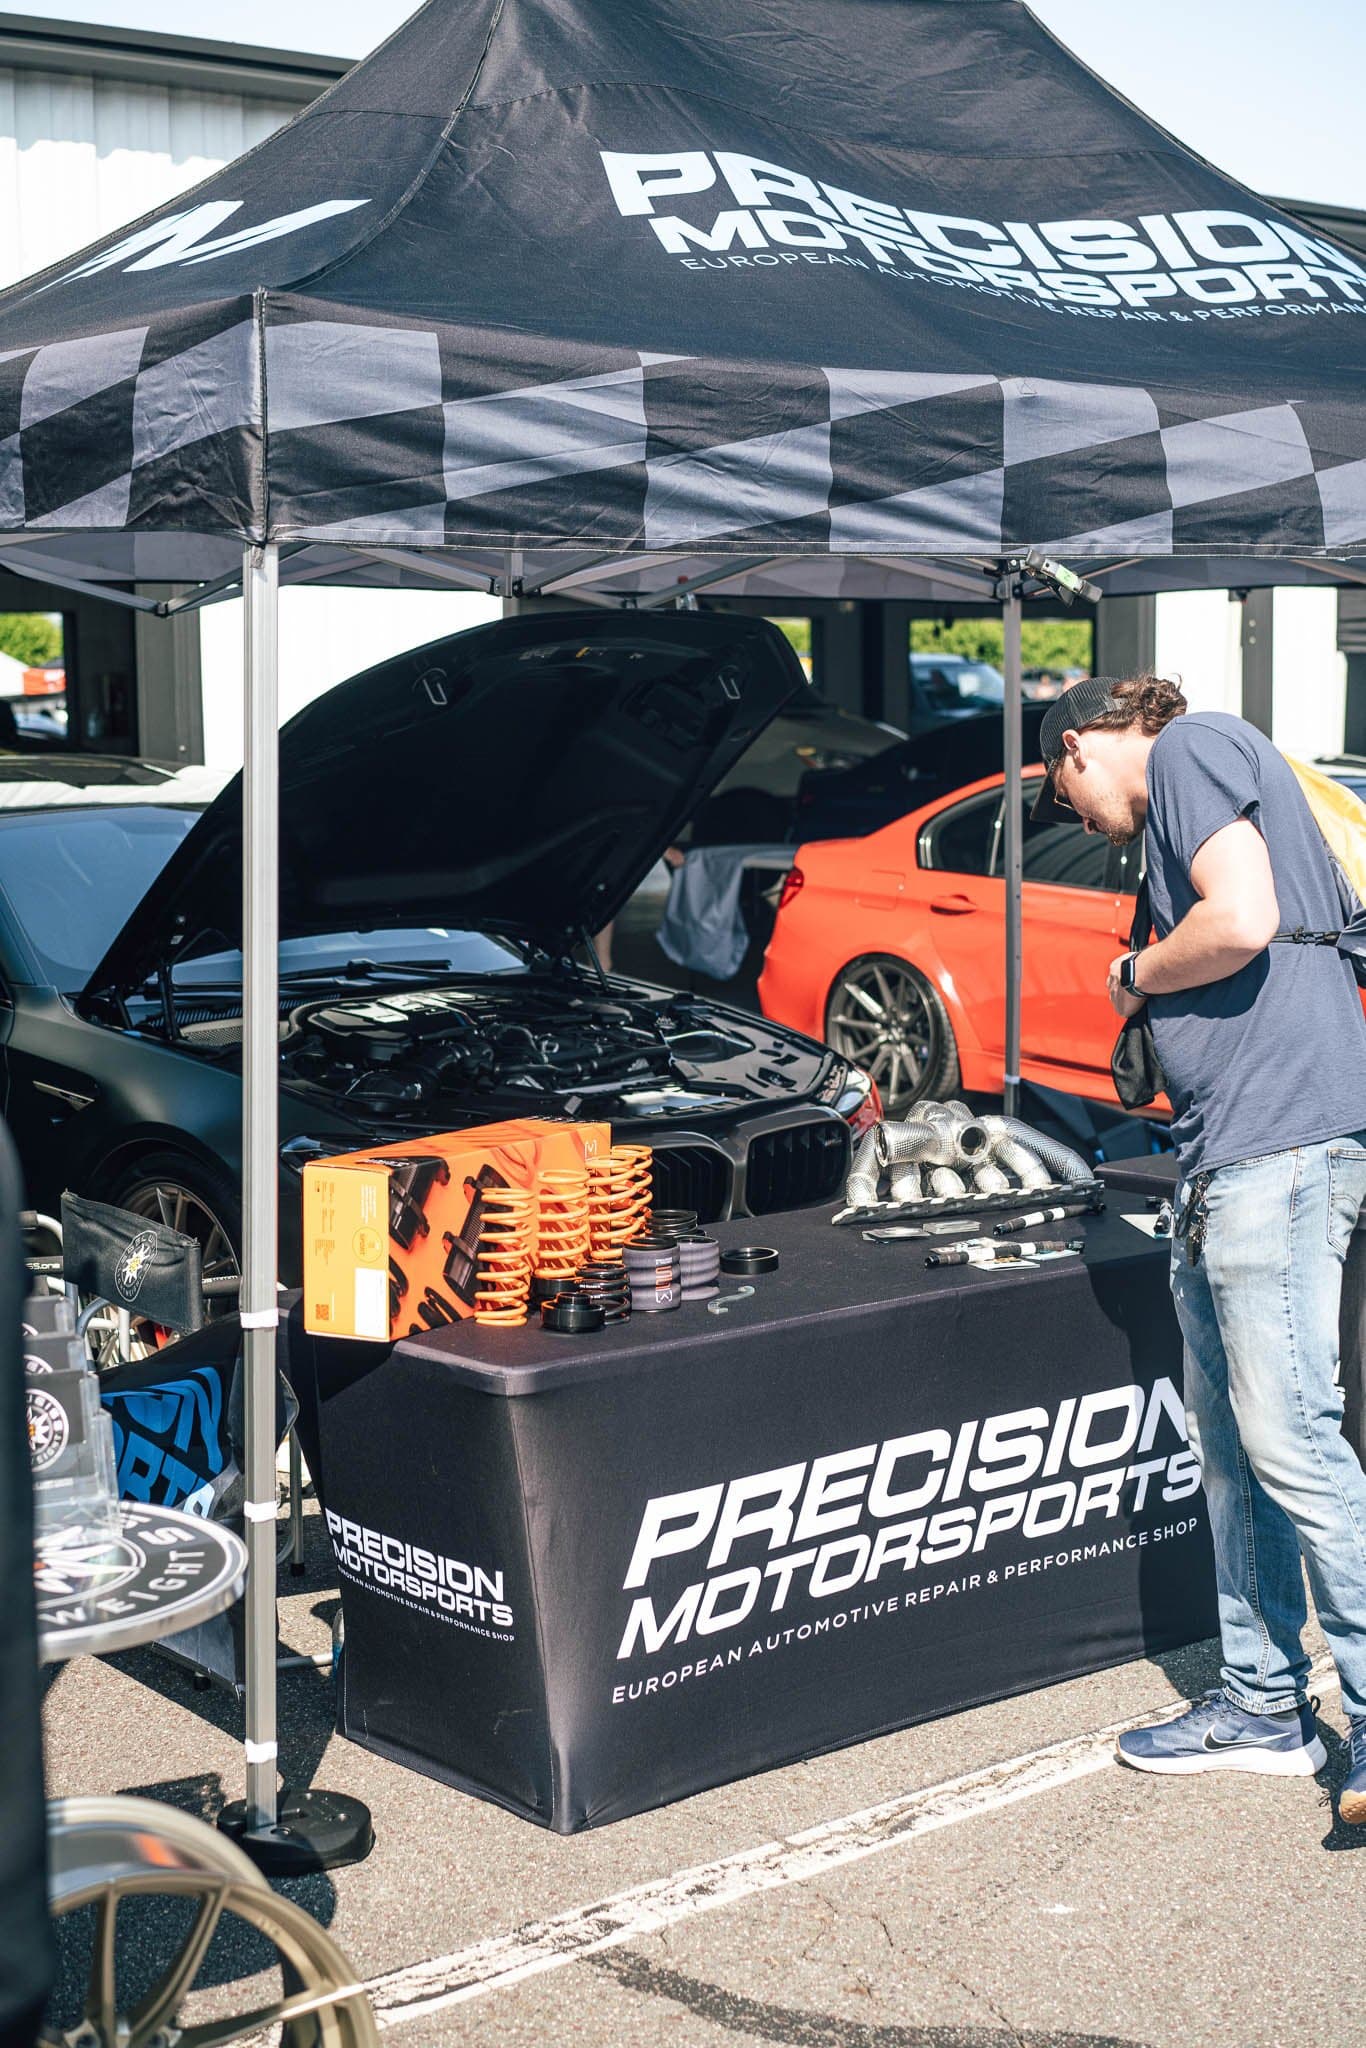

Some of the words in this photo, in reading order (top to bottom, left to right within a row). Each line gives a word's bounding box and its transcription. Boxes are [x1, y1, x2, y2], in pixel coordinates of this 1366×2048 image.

[599, 151, 1366, 280] PRECISION
[648, 209, 1366, 307] MOTORSPORT
[680, 252, 869, 270] EUROPEAN
[877, 263, 1063, 314] AUTOMOTIVE
[1064, 305, 1168, 322] REPAIR
[1169, 311, 1193, 322] &
[1195, 302, 1366, 321] PERFORMAN
[622, 1376, 1188, 1590] PRECISION
[325, 1507, 504, 1601] PRECISION
[333, 1538, 514, 1627] MOTORSPORTS
[616, 1449, 1202, 1660] MOTORSPORTS
[364, 1582, 405, 1605] AUTOMOTIVE
[405, 1600, 430, 1615] REPAIR
[436, 1612, 490, 1637] PERFORMANCE
[491, 1631, 515, 1642] SHOP
[612, 1646, 742, 1704] EUROPEAN
[749, 1596, 899, 1657] AUTOMOTIVE
[905, 1574, 981, 1608] REPAIR
[987, 1570, 999, 1584] &
[1004, 1532, 1149, 1580] PERFORMANCE
[1153, 1517, 1198, 1542] SHOP
